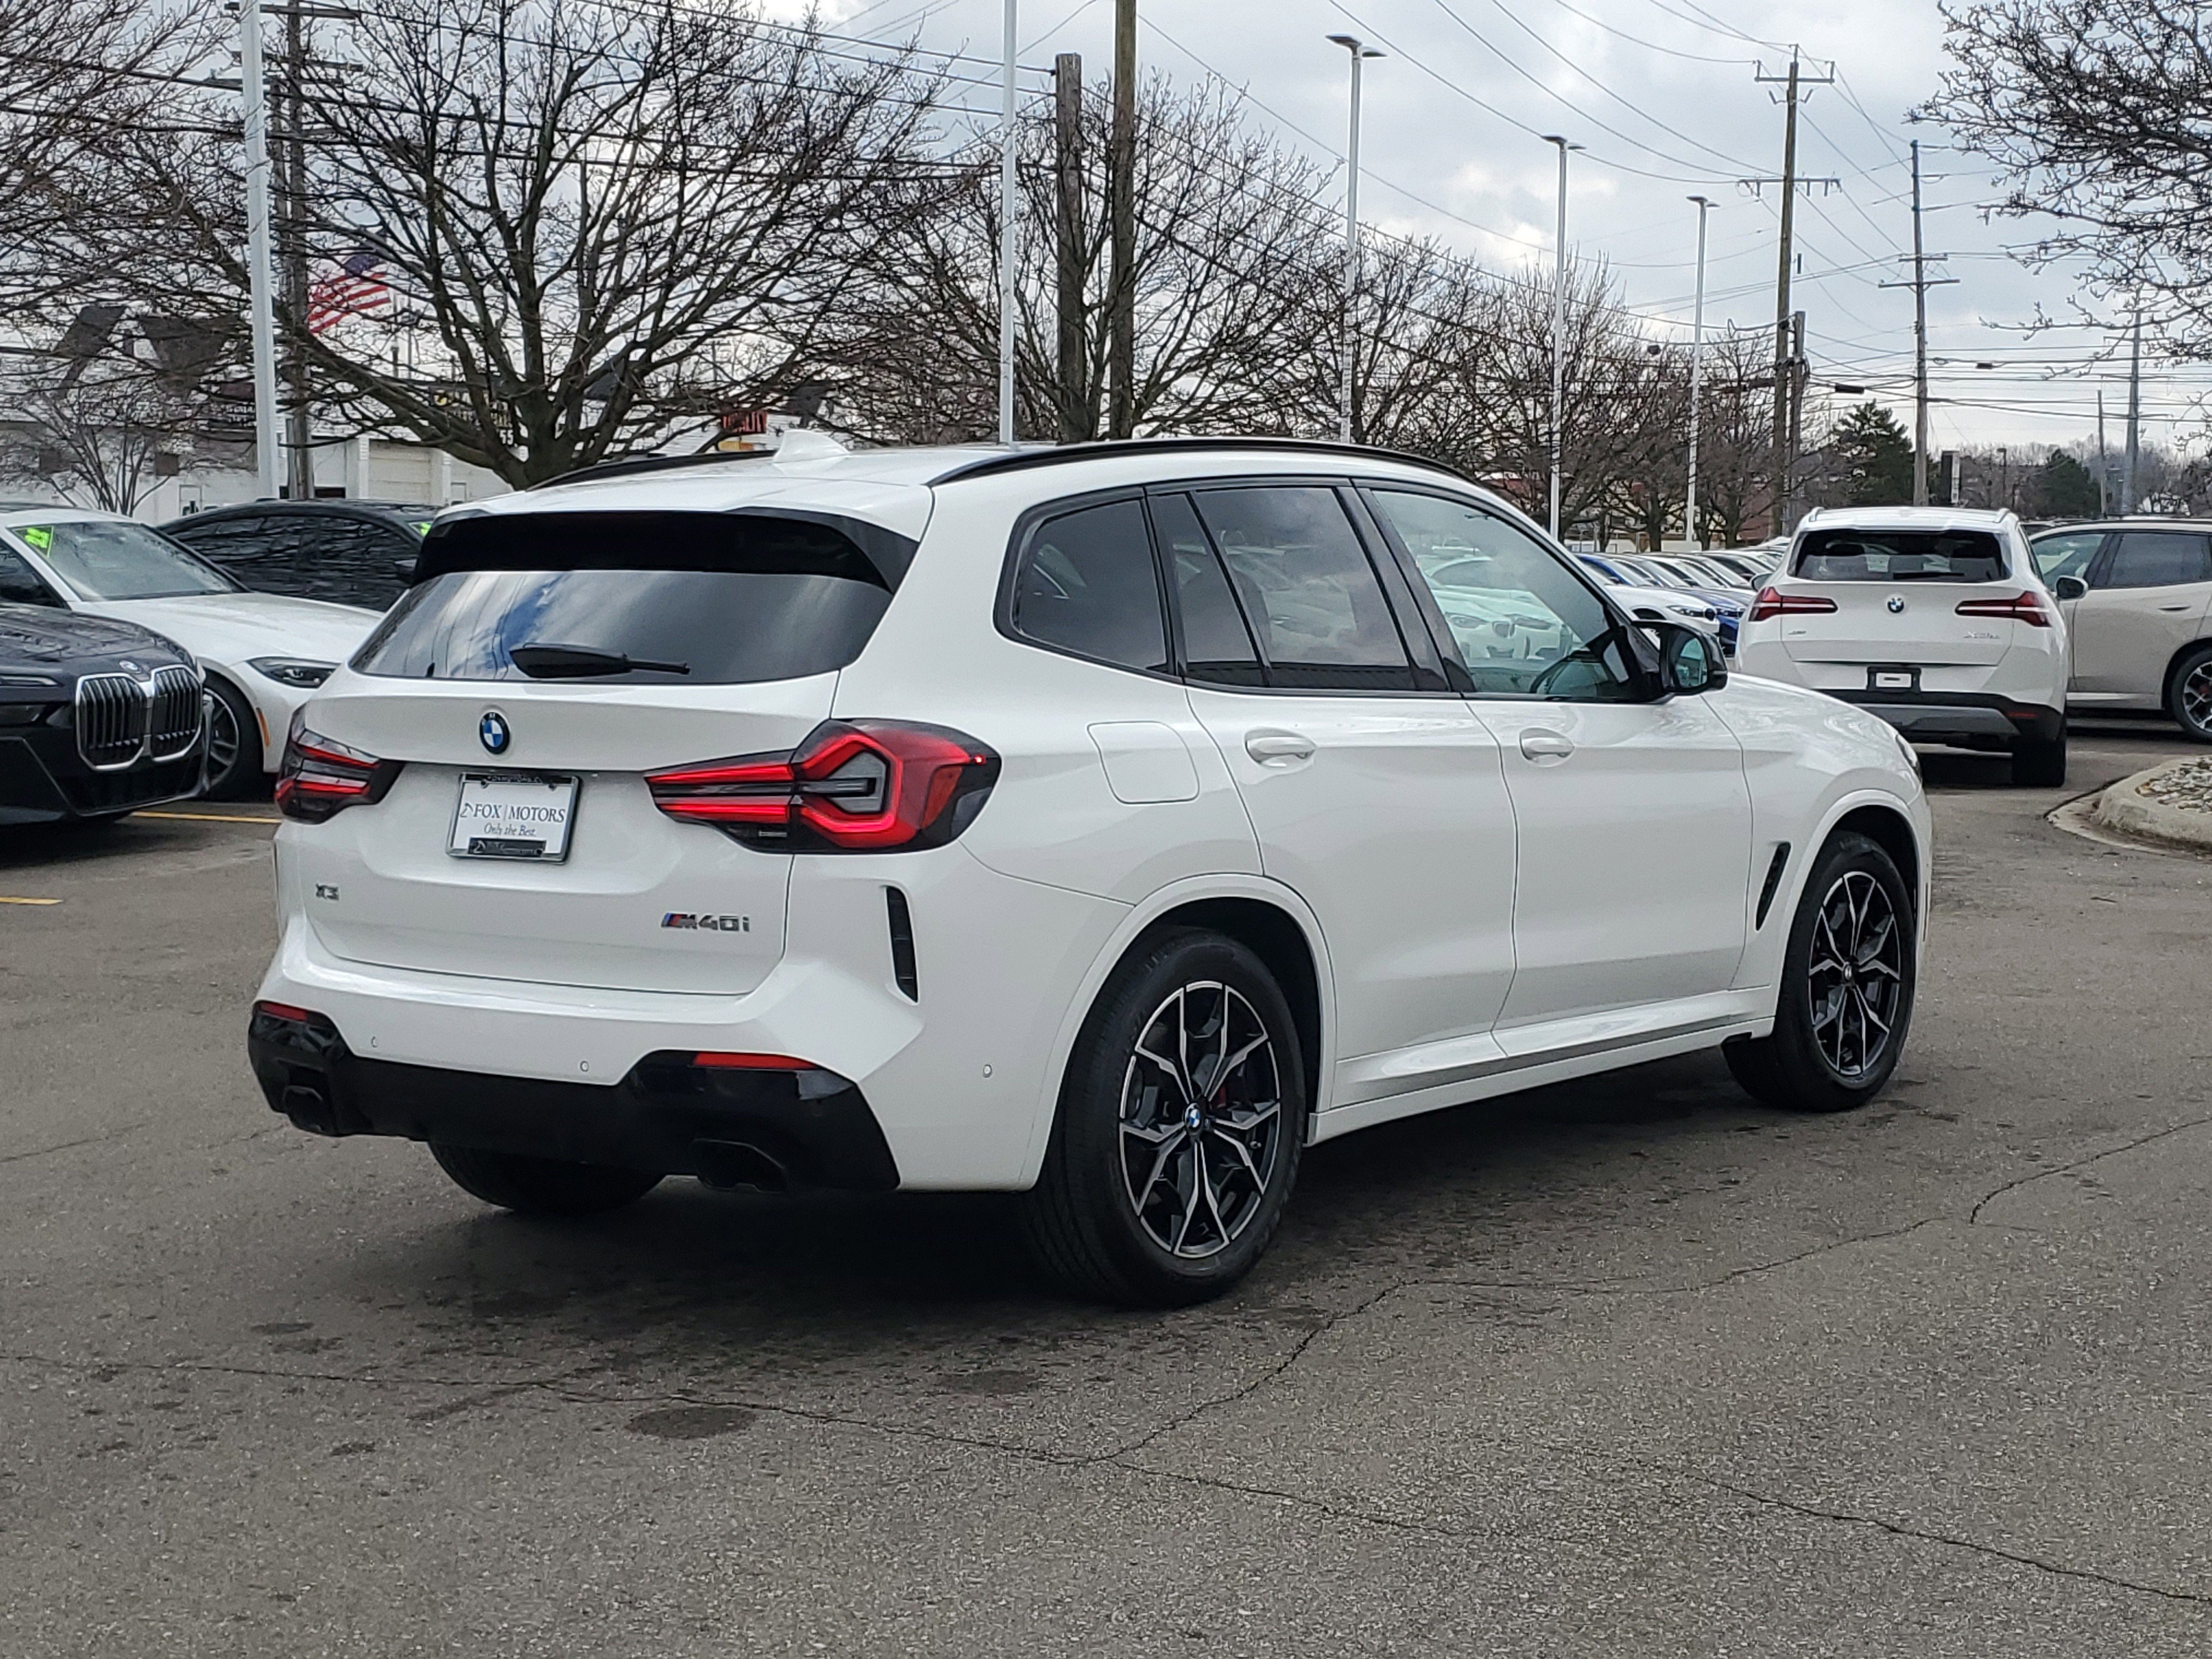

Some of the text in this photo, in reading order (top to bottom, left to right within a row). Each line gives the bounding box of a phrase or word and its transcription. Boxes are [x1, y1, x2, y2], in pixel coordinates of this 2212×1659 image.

[474, 803, 566, 823] FOX MOTORS
[484, 822, 503, 836] Only
[505, 824, 517, 836] the
[315, 884, 340, 900] X3
[661, 912, 750, 932] M40i
